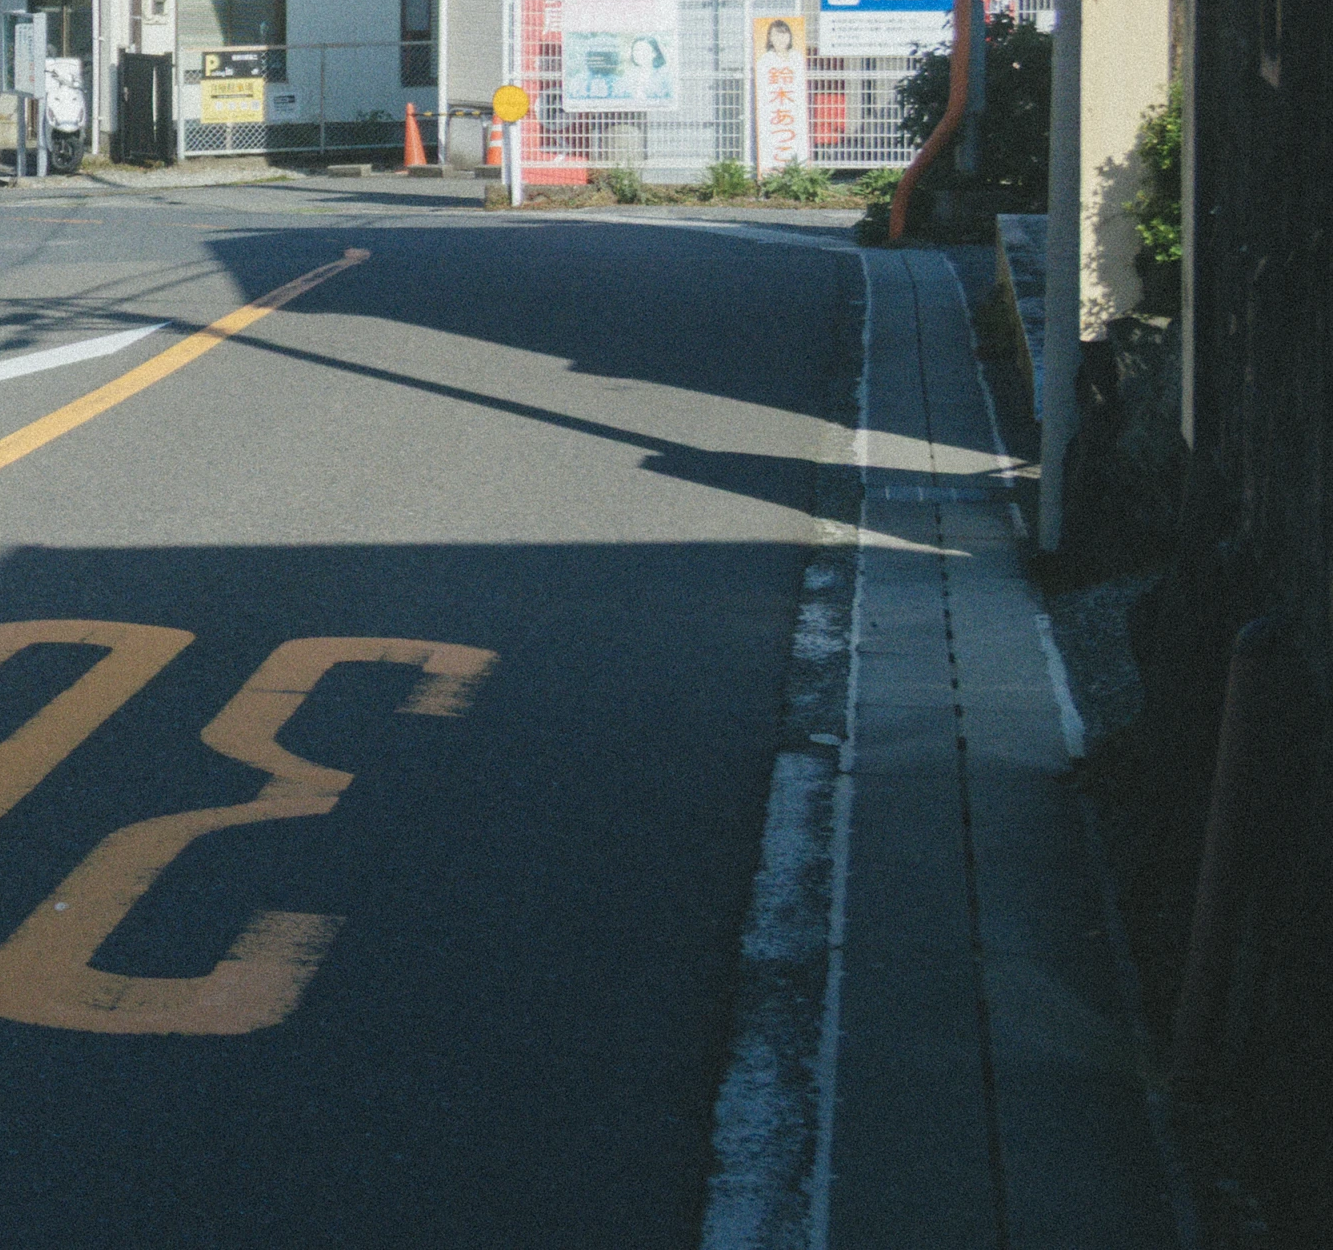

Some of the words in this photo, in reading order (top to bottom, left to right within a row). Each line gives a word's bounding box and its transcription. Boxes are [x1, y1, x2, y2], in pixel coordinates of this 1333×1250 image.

[767, 65, 797, 163] 鈴木あつこ
